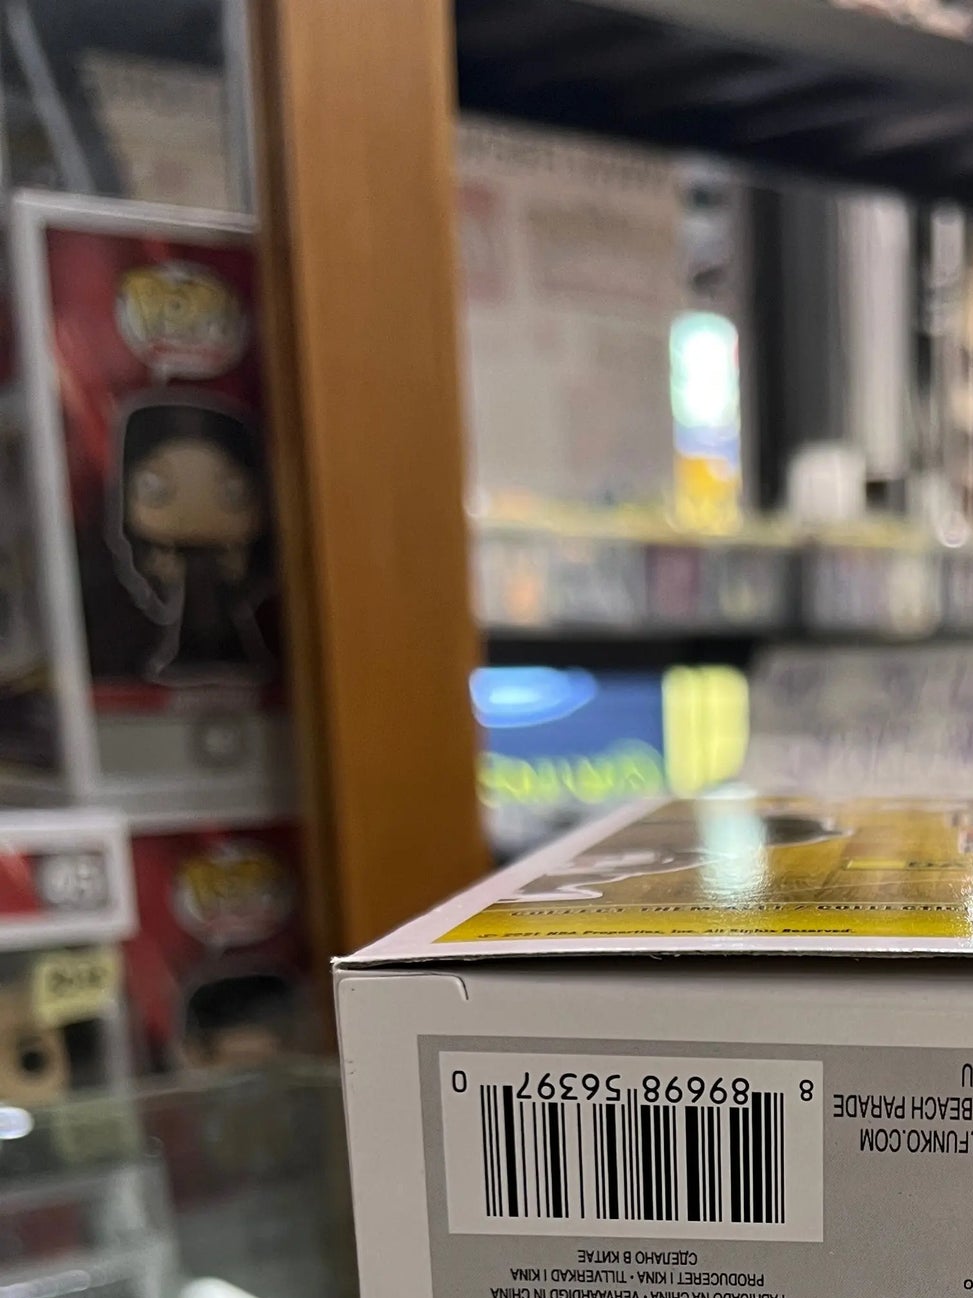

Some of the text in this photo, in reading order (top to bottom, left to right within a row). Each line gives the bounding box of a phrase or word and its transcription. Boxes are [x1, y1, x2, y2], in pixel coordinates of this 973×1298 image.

[515, 1071, 621, 1100] 56397
[640, 1074, 749, 1104] 89698
[832, 1093, 905, 1119] PARADE
[622, 1250, 632, 1264] В
[634, 1249, 698, 1265] СДЕЛАНО
[509, 1267, 540, 1281] KINA
[550, 1268, 625, 1284] TILLVERKAD
[636, 1270, 667, 1284] KINA
[678, 1271, 764, 1287] PRODUCERET
